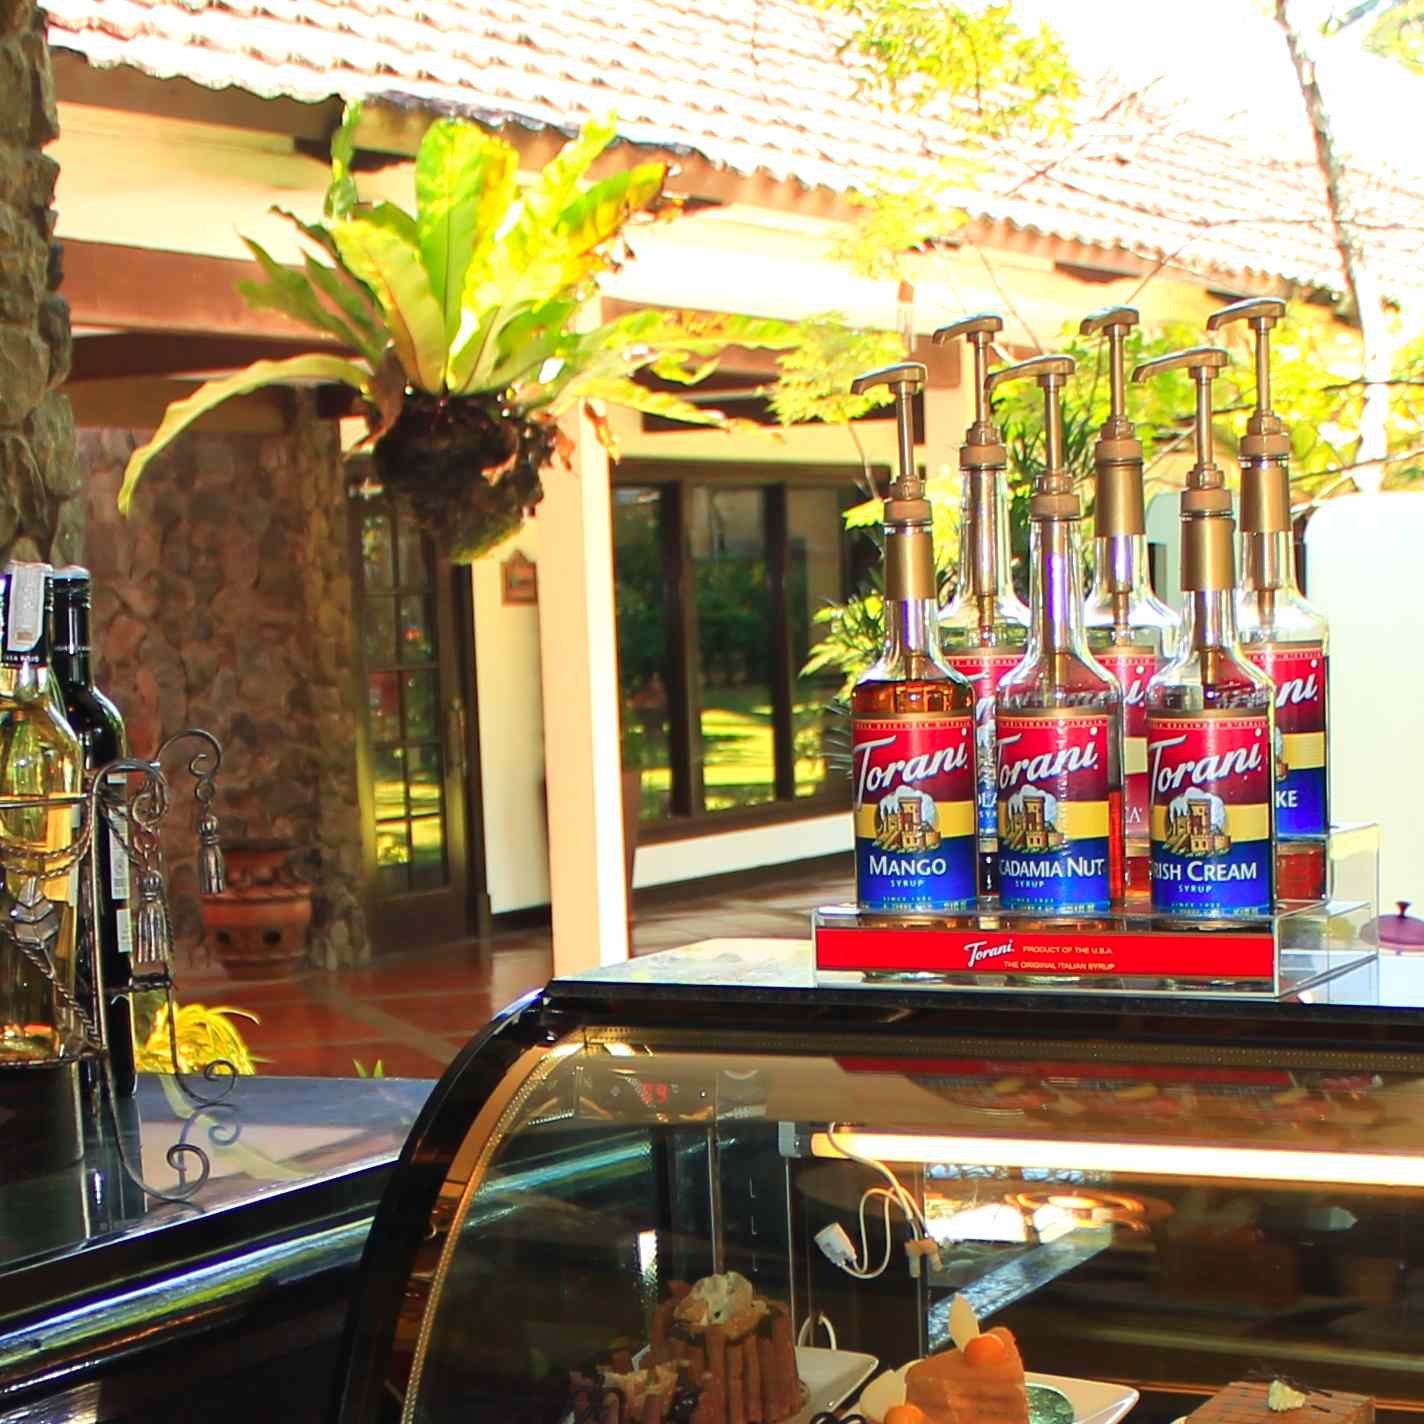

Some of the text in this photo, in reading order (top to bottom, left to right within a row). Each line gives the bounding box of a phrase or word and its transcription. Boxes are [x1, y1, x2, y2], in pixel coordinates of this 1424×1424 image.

[855, 727, 968, 811] Torani
[1149, 728, 1262, 806] Torani
[870, 855, 947, 876] MANGO
[1068, 856, 1104, 876] NUT
[1153, 860, 1257, 882] RISH CREAM
[890, 879, 924, 888] SYRUP
[1179, 884, 1212, 893] SYRUP
[964, 939, 1015, 967] Torani
[1075, 946, 1089, 954] THE
[1020, 961, 1056, 969] ORIGINAL
